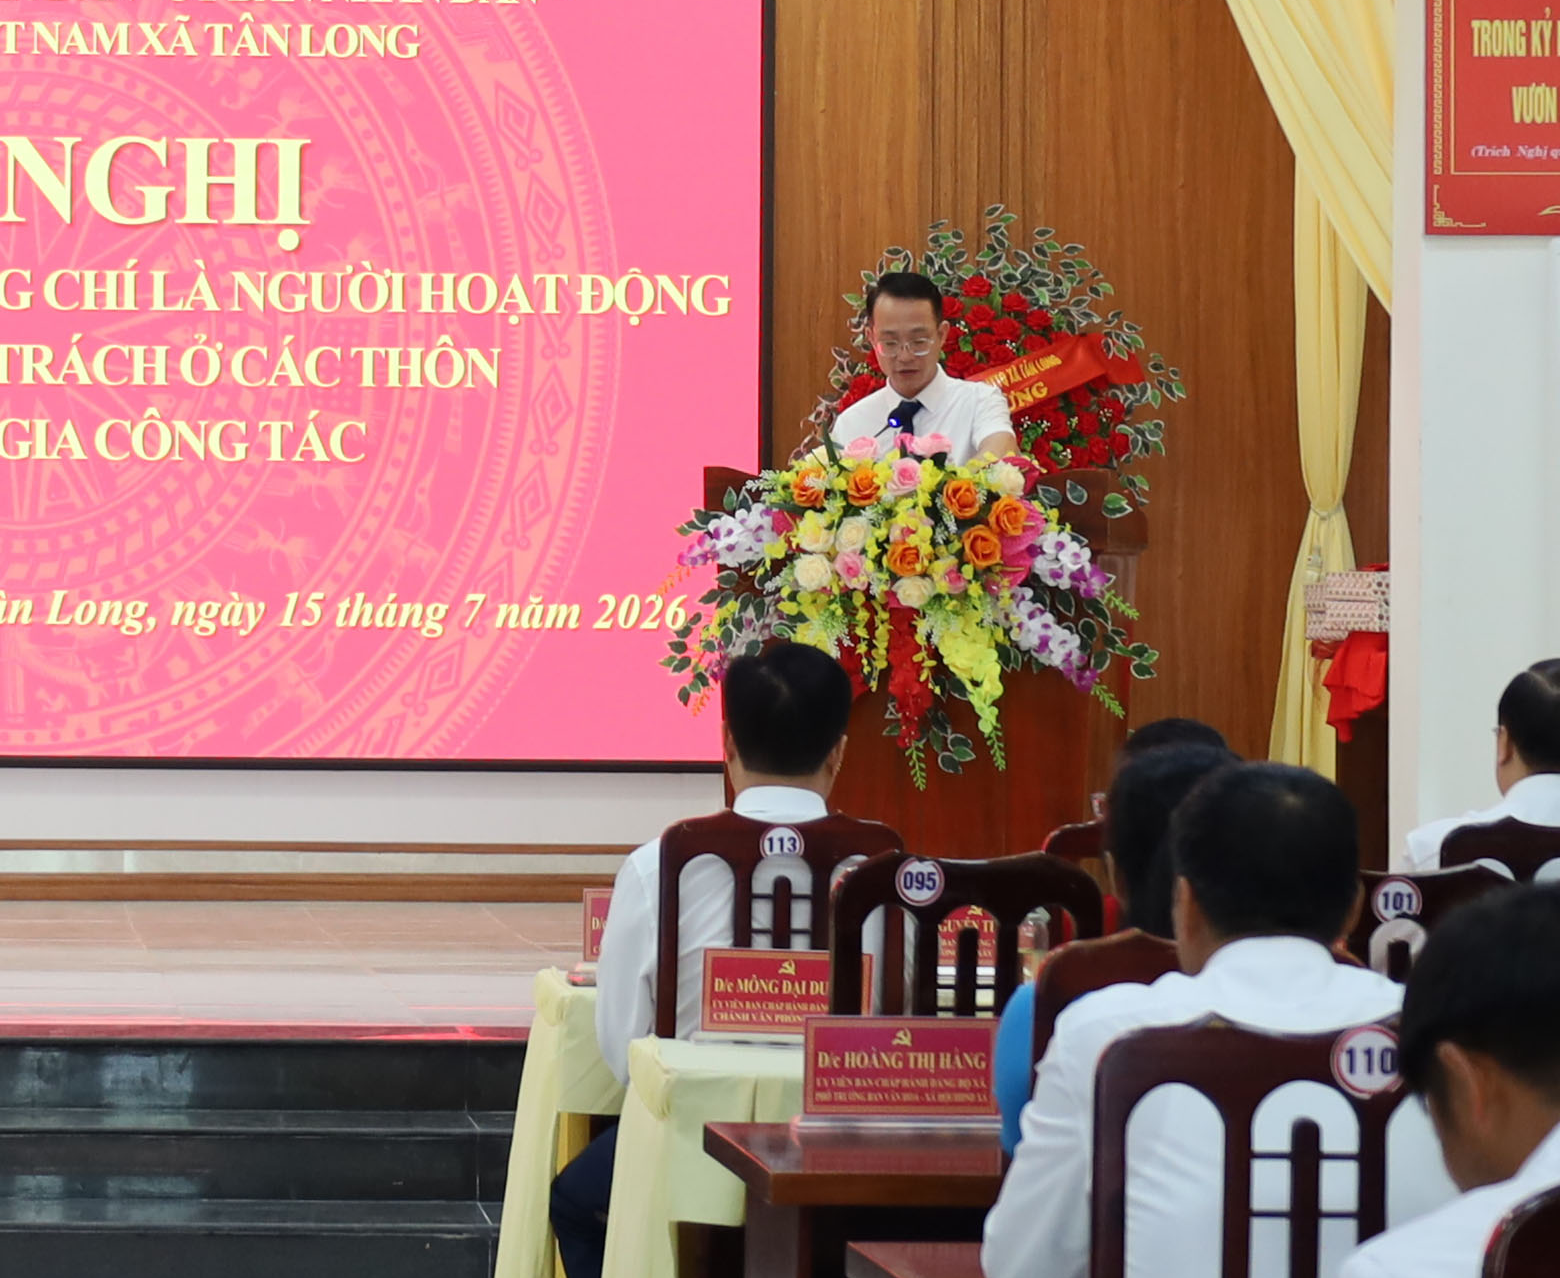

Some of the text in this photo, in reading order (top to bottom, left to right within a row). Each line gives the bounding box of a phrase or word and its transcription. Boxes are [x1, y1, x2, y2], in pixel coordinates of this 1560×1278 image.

[32, 22, 130, 55] NAM
[137, 15, 198, 55] XÃ
[204, 12, 290, 56] TÂN
[299, 24, 419, 58] LONG
[1512, 82, 1557, 124] VƯƠN
[44, 261, 138, 310] CHÍ
[150, 261, 220, 310] LÀ
[230, 263, 406, 313] NGƯỜI
[418, 273, 568, 324] HOẠT
[576, 268, 730, 325] ĐỘNG
[180, 333, 223, 386] Ở
[231, 335, 341, 387] CÁC
[351, 335, 501, 388] THÔN
[95, 407, 248, 461] CÔNG
[259, 410, 365, 462] TÁC
[45, 590, 156, 635] Long,
[171, 592, 265, 635] ngày
[280, 592, 324, 626] 15
[336, 593, 448, 637] tháng
[465, 594, 485, 627] 7
[495, 595, 580, 628] năm
[593, 594, 687, 629] 2026
[767, 836, 798, 853] 113
[903, 871, 938, 891] 095
[1382, 891, 1415, 911] 101
[1345, 1046, 1399, 1075] 110
